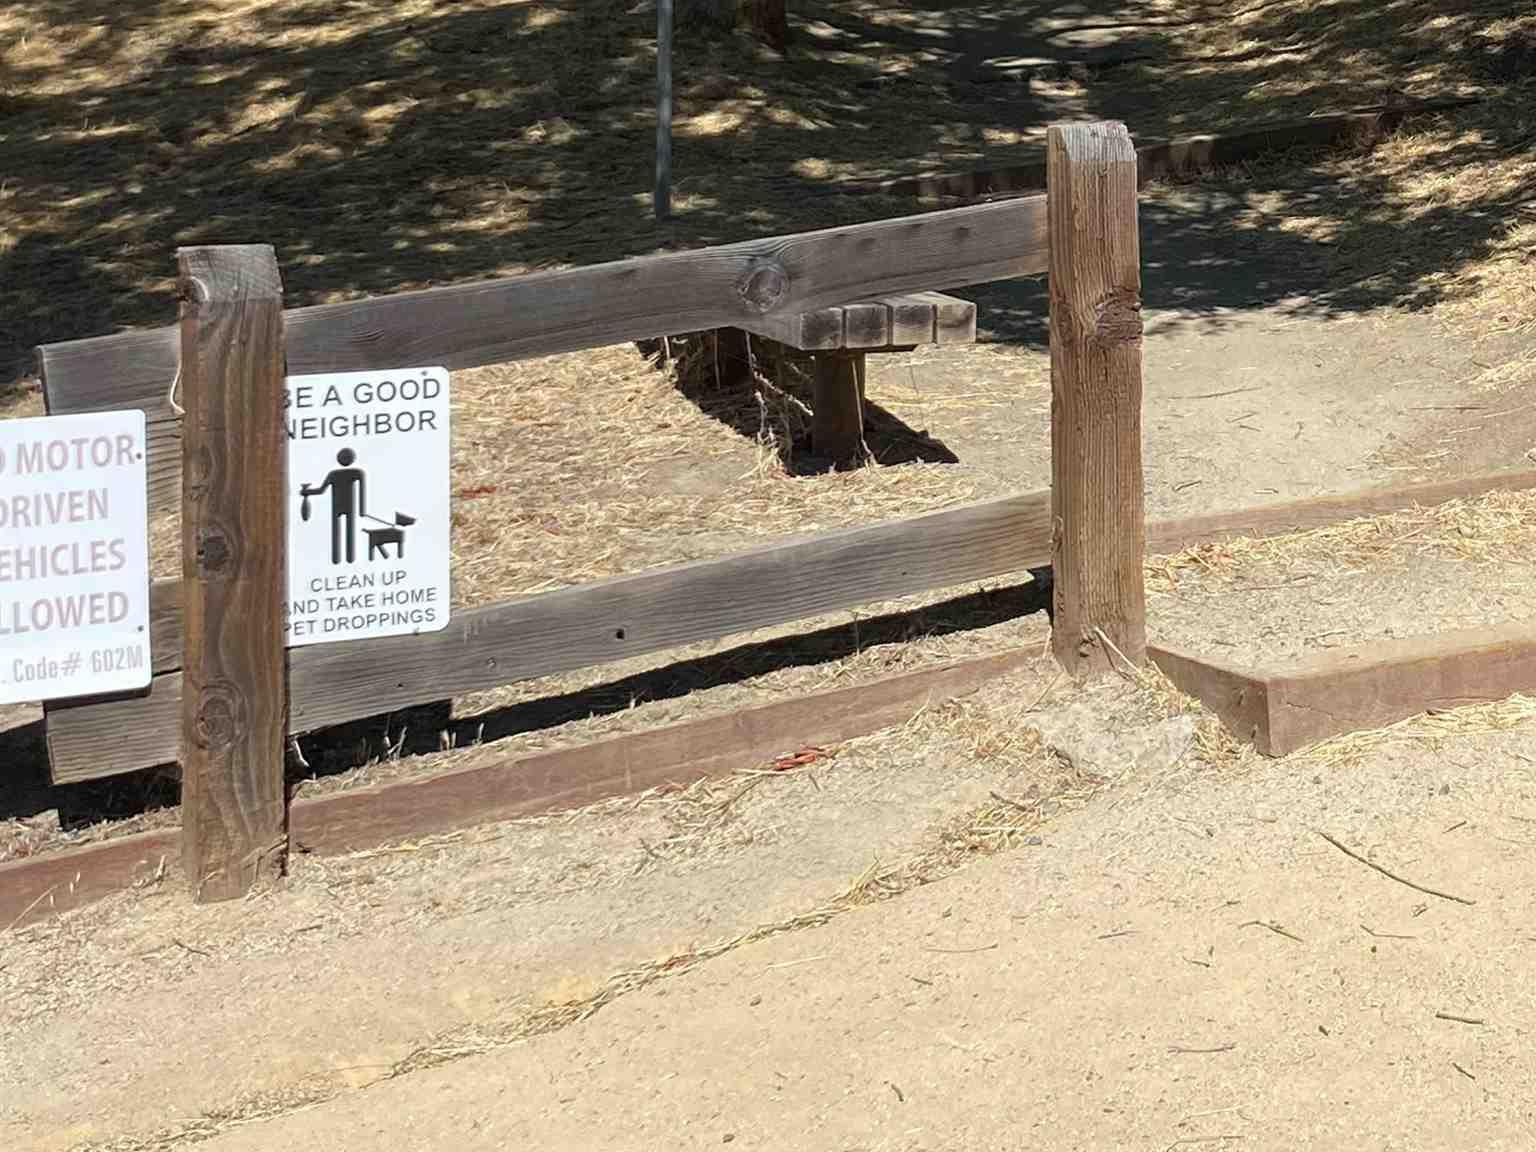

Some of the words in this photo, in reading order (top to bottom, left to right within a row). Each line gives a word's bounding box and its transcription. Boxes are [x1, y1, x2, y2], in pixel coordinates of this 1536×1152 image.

[322, 385, 343, 407] A
[353, 378, 440, 404] GOOD
[16, 434, 135, 474] MOTOR
[0, 538, 126, 581] EHICLES
[311, 573, 375, 593] CLEAN
[382, 570, 407, 586] UP
[327, 593, 375, 612] TAKE
[382, 587, 437, 606] HOME
[323, 607, 436, 633] DROPPINGS
[91, 645, 143, 673] 602M
